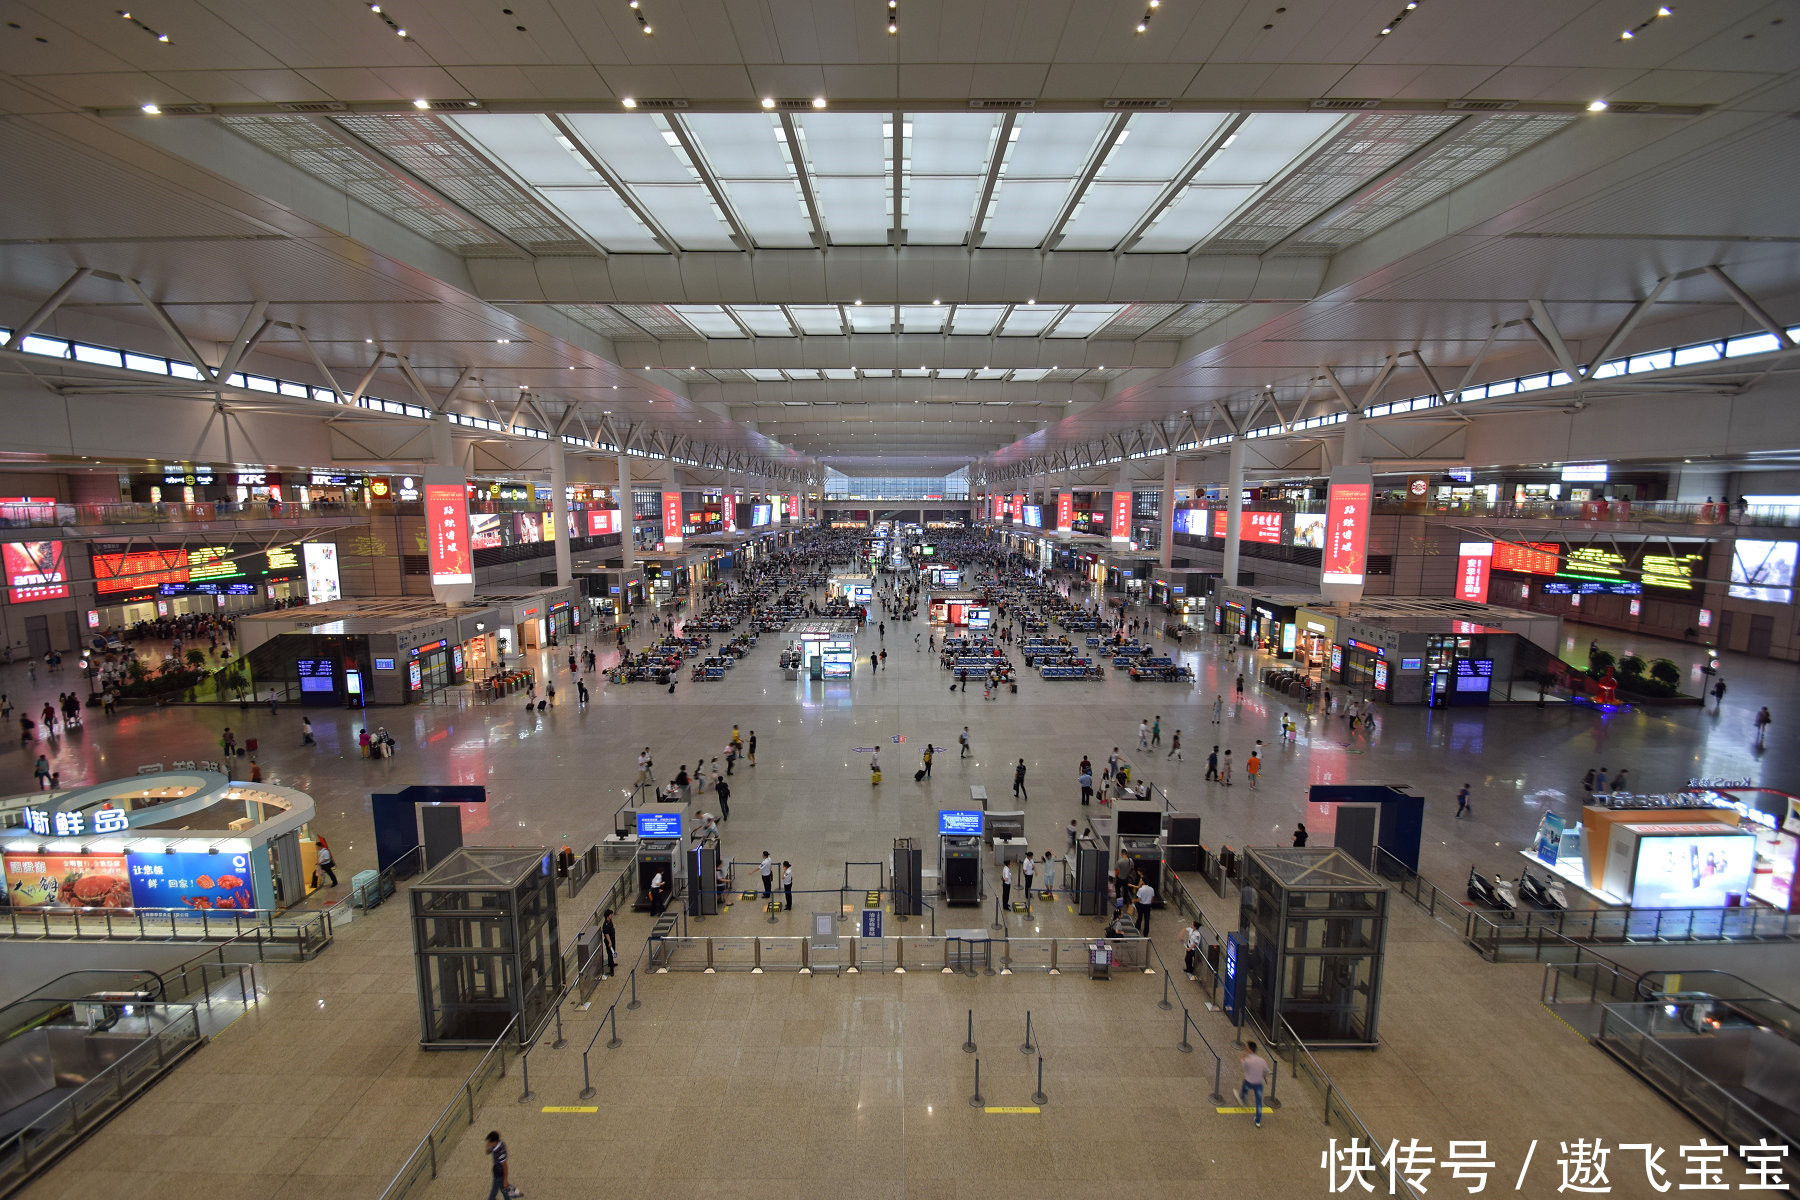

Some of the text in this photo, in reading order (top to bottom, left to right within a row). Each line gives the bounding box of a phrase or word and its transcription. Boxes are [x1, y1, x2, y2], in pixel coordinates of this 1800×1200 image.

[238, 475, 266, 484] KFC
[311, 476, 331, 485] KFC
[31, 808, 129, 836] 新鲜岛
